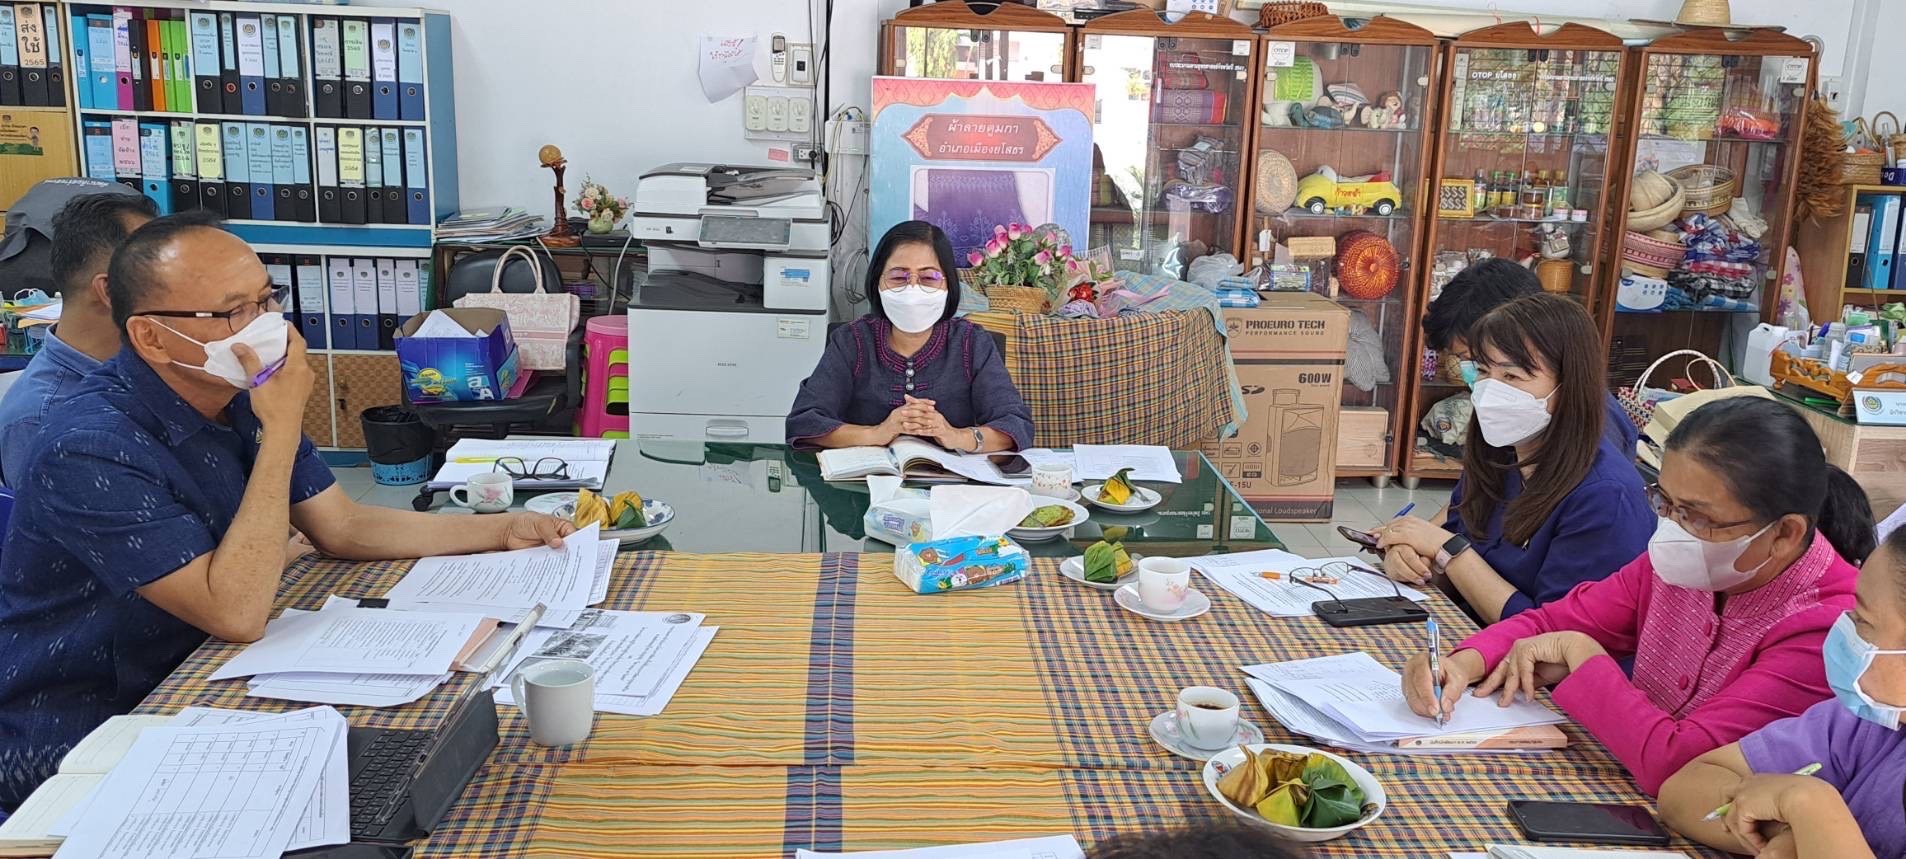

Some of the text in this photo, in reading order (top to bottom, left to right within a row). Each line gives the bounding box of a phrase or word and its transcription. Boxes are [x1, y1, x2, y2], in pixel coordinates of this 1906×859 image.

[21, 20, 37, 33] ส่ง
[21, 36, 40, 53] ใช้
[1472, 71, 1493, 79] OTOP
[939, 141, 1024, 155] อำเภอเมืองยโสธร
[1246, 320, 1326, 330] PROEURO TECH
[1298, 373, 1332, 384] 600W
[1274, 507, 1318, 517] Loudspeaker
